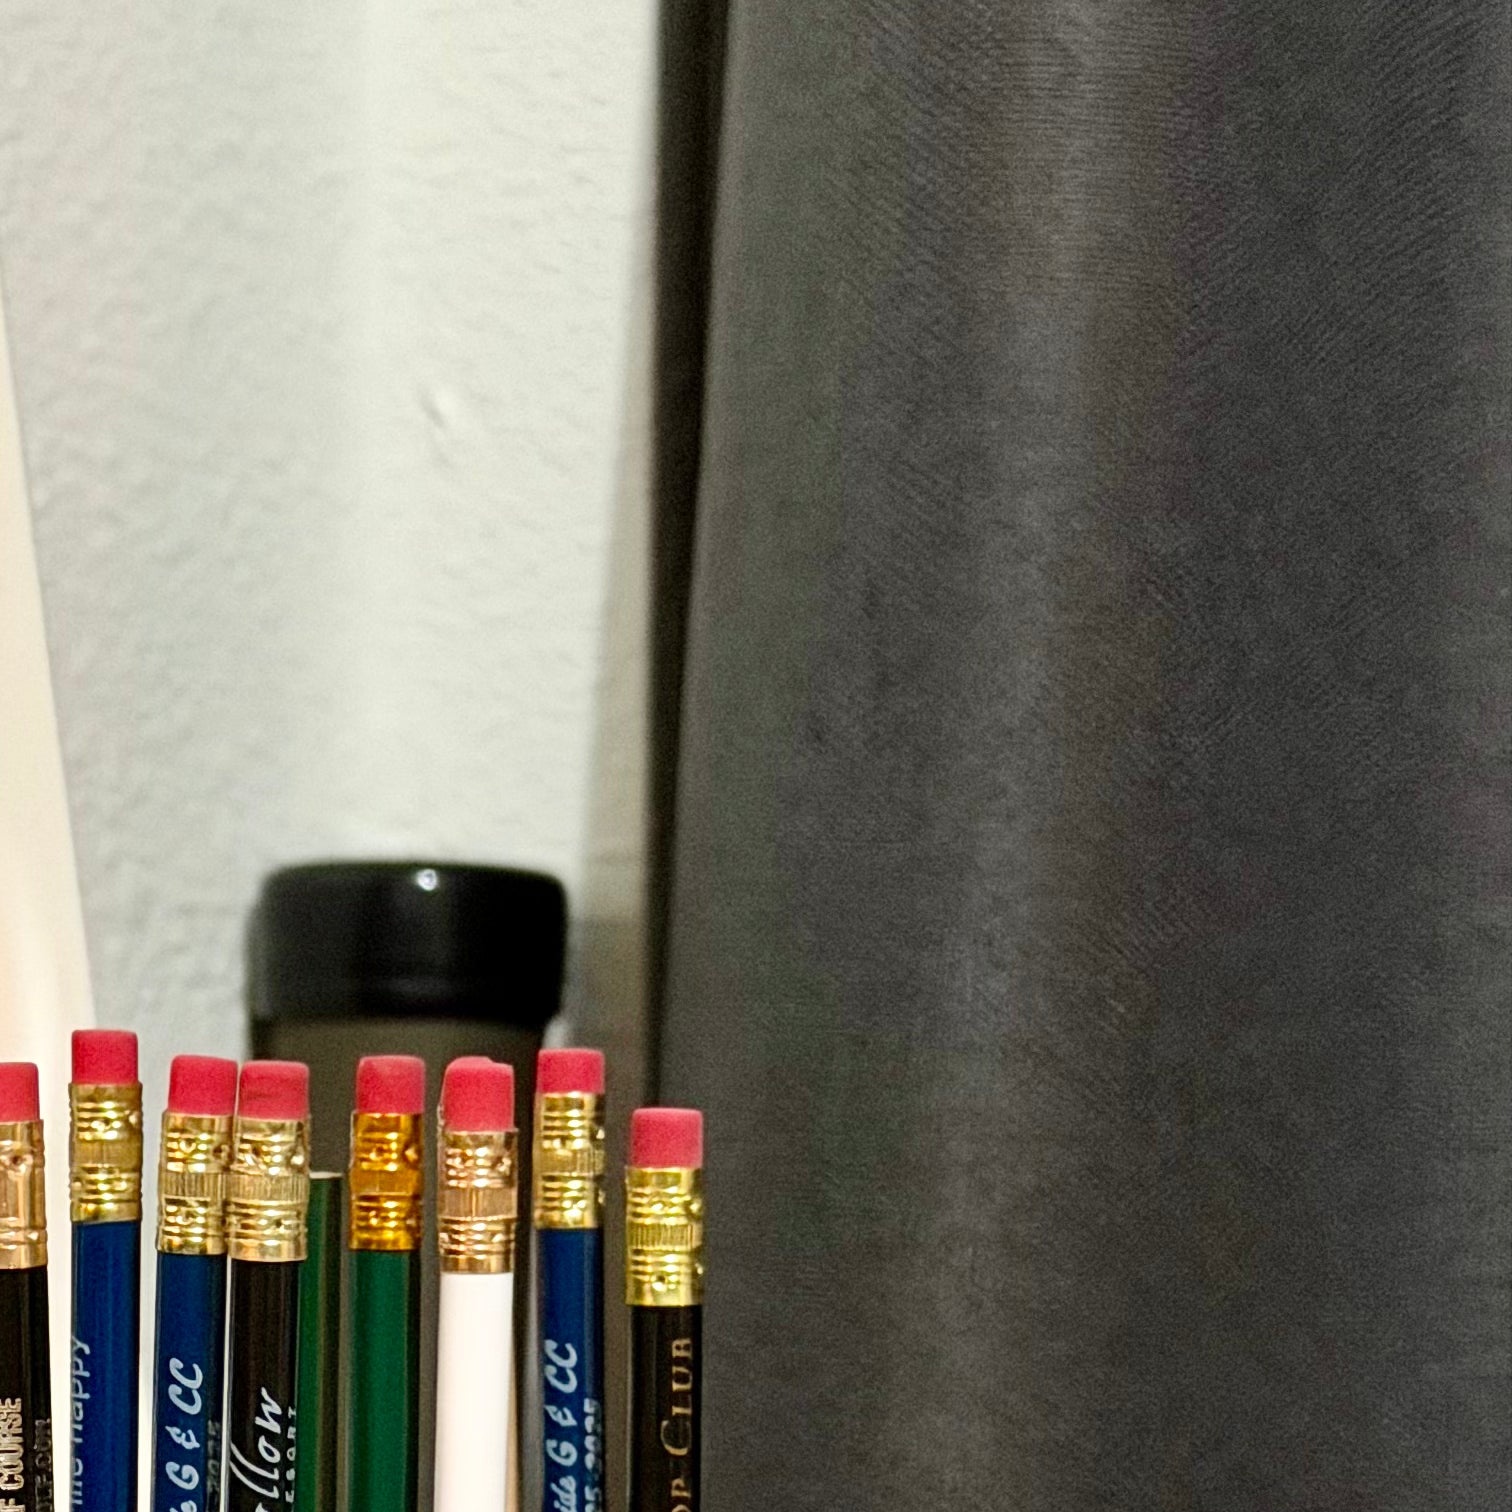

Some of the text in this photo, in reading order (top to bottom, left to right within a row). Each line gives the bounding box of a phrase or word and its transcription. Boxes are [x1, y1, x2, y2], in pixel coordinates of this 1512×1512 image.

[168, 1356, 204, 1416] CC
[544, 1339, 577, 1394] CC
[659, 1337, 694, 1457] CLUB
[165, 1461, 200, 1491] G
[546, 1438, 578, 1467] G
